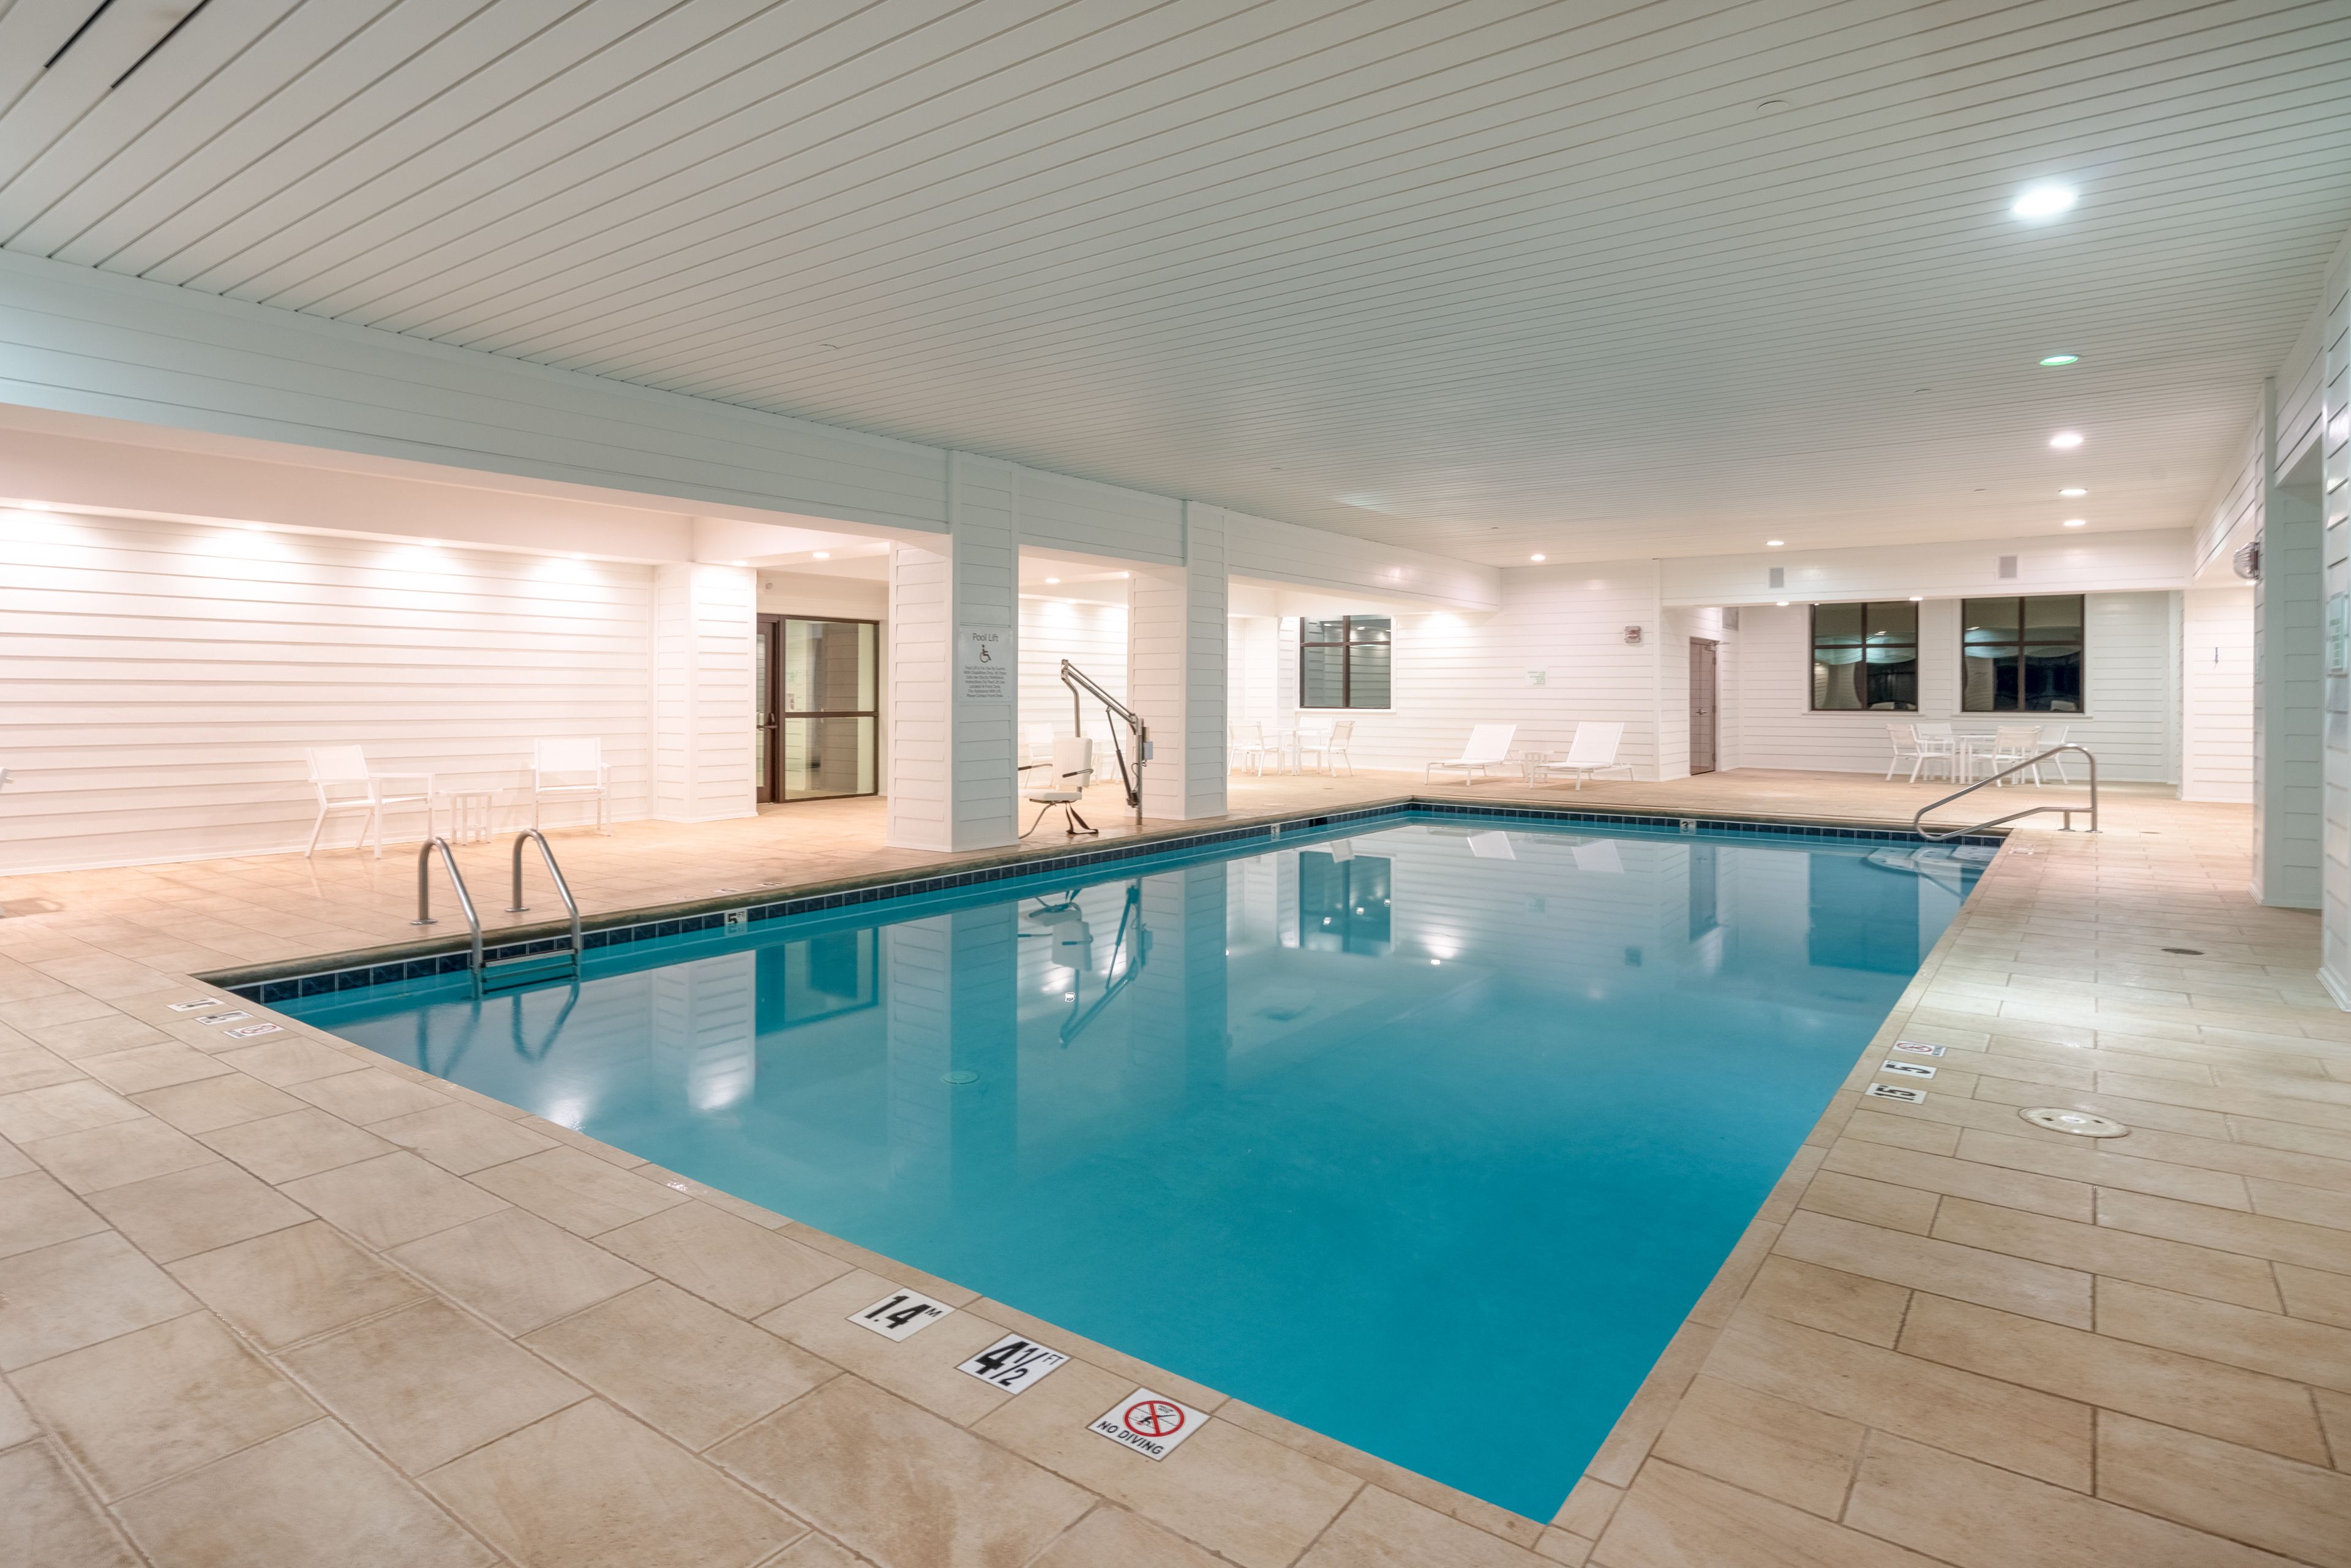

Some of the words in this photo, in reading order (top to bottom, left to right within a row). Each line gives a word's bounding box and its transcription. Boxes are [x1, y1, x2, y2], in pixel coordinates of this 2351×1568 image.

[972, 632, 987, 641] Pool
[727, 913, 737, 925] 5
[1885, 1064, 1931, 1074] 5
[864, 1296, 932, 1329] 1.4
[924, 1308, 943, 1317] M
[1043, 1354, 1063, 1365] FT
[1097, 1420, 1118, 1433] NO
[1118, 1430, 1164, 1454] DIVING
